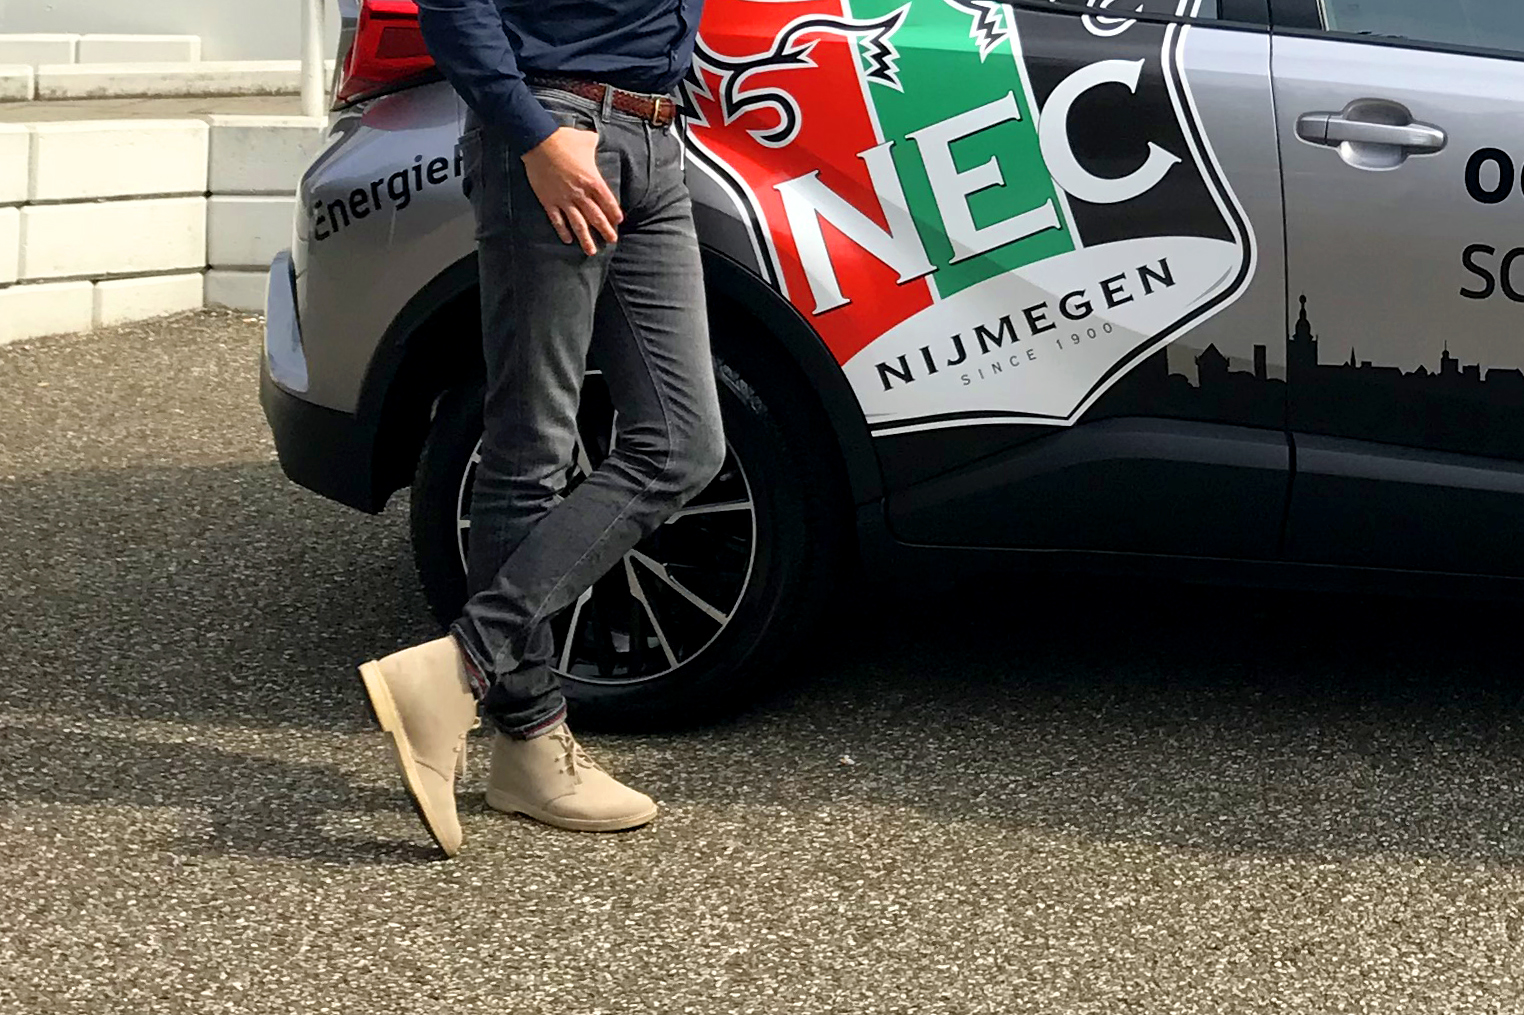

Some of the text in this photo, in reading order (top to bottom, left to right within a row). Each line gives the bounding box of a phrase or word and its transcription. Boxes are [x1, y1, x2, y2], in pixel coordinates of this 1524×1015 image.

[773, 58, 1182, 316] NEC
[875, 257, 1177, 392] NIJMEGEN
[960, 322, 1114, 386] SINCE 1900
